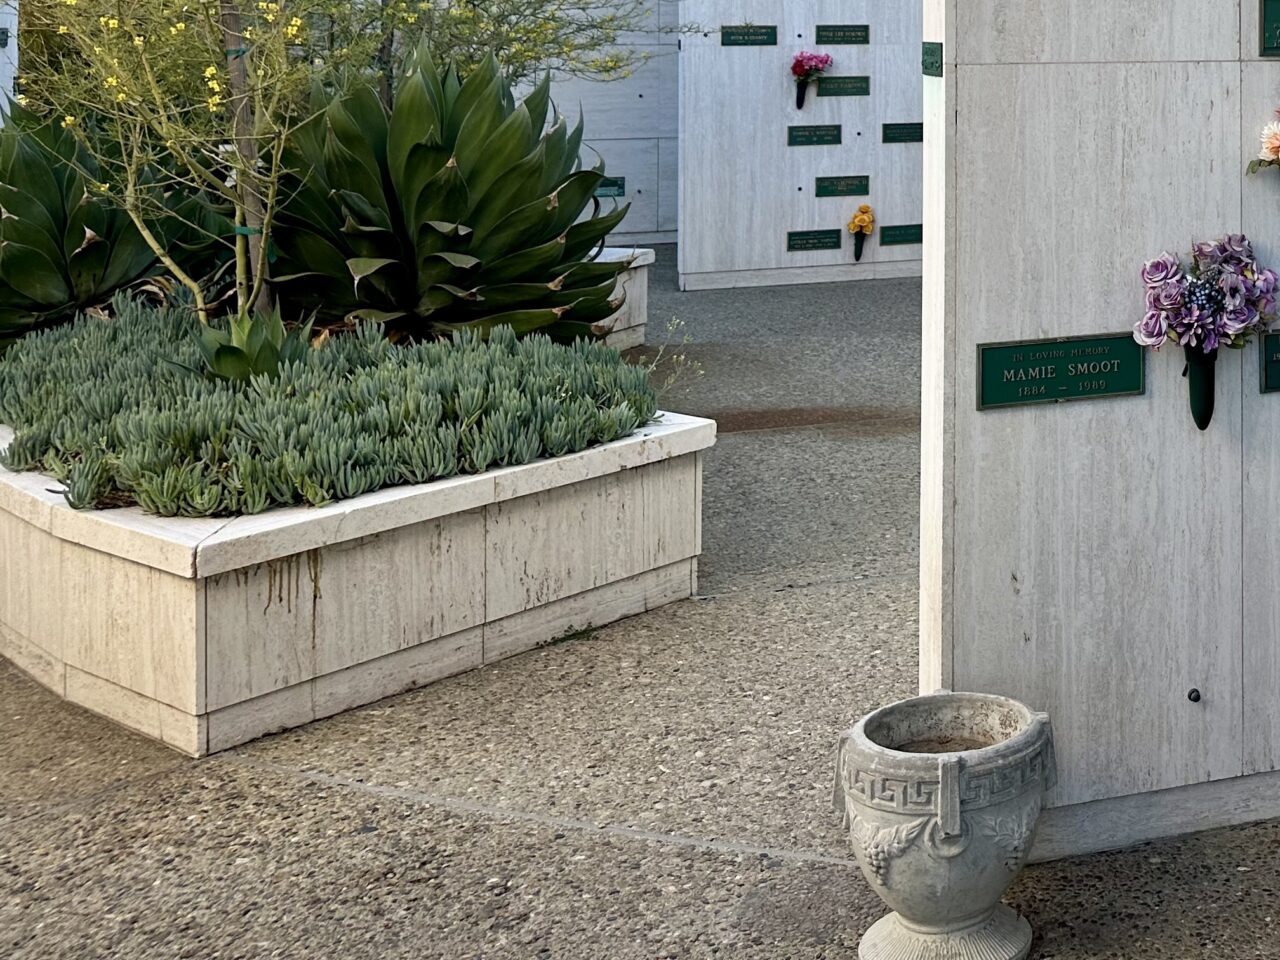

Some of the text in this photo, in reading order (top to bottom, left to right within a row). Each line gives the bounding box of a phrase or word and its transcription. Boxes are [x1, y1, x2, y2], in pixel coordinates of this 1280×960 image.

[1030, 349, 1065, 360] LOVING
[1071, 345, 1110, 357] MEMORY
[1003, 358, 1121, 382] MAMIE SMOOT
[1018, 379, 1106, 397] 1884 1989
